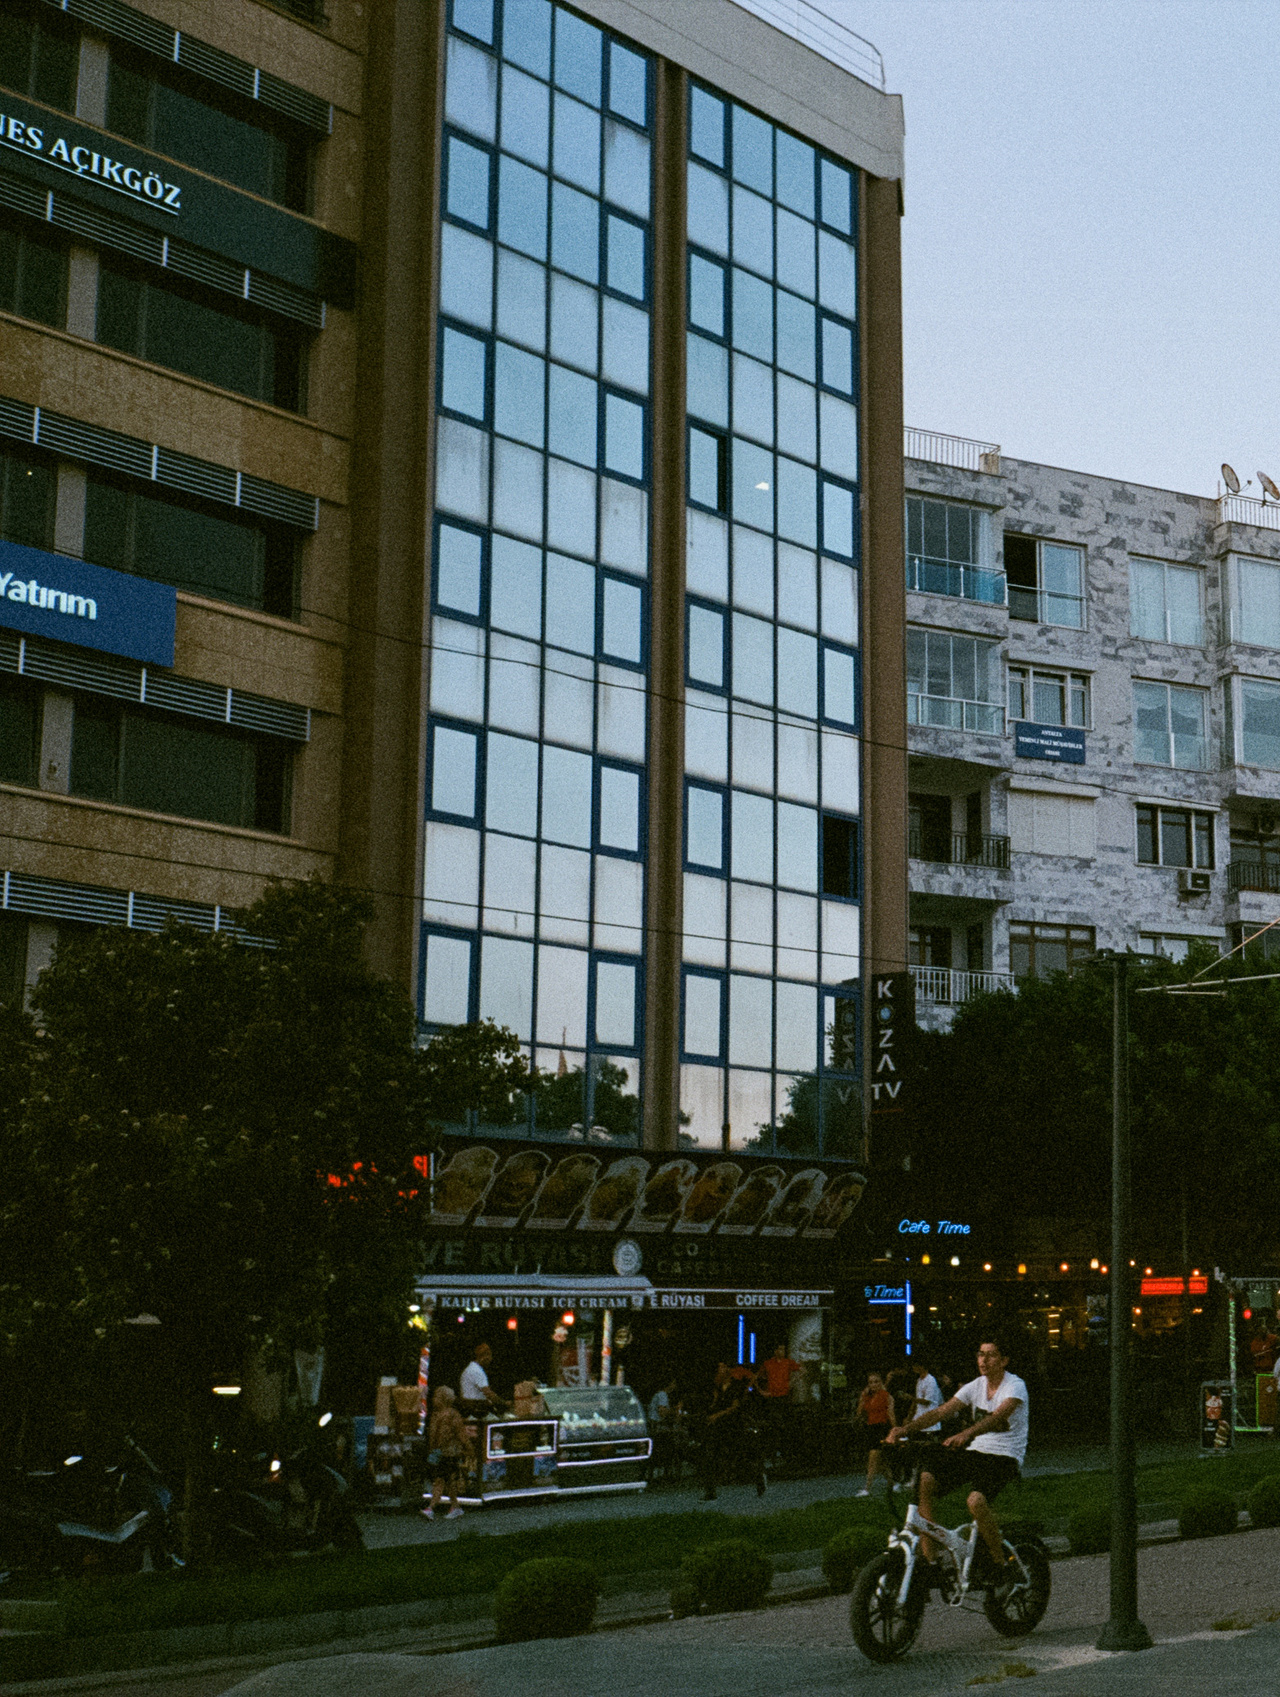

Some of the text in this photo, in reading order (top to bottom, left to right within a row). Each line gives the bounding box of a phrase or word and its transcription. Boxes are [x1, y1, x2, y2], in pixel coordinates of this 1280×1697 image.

[48, 138, 182, 209] AÇIKGÖZ
[871, 1081, 902, 1100] TV
[898, 1219, 971, 1236] Cafe Time
[873, 1285, 905, 1298] Time
[441, 1294, 628, 1309] KAHVE RÜYASI ICE CREAM
[661, 1292, 706, 1308] RÜYASI
[735, 1294, 778, 1307] COFFEE
[781, 1294, 820, 1307] DREAM
